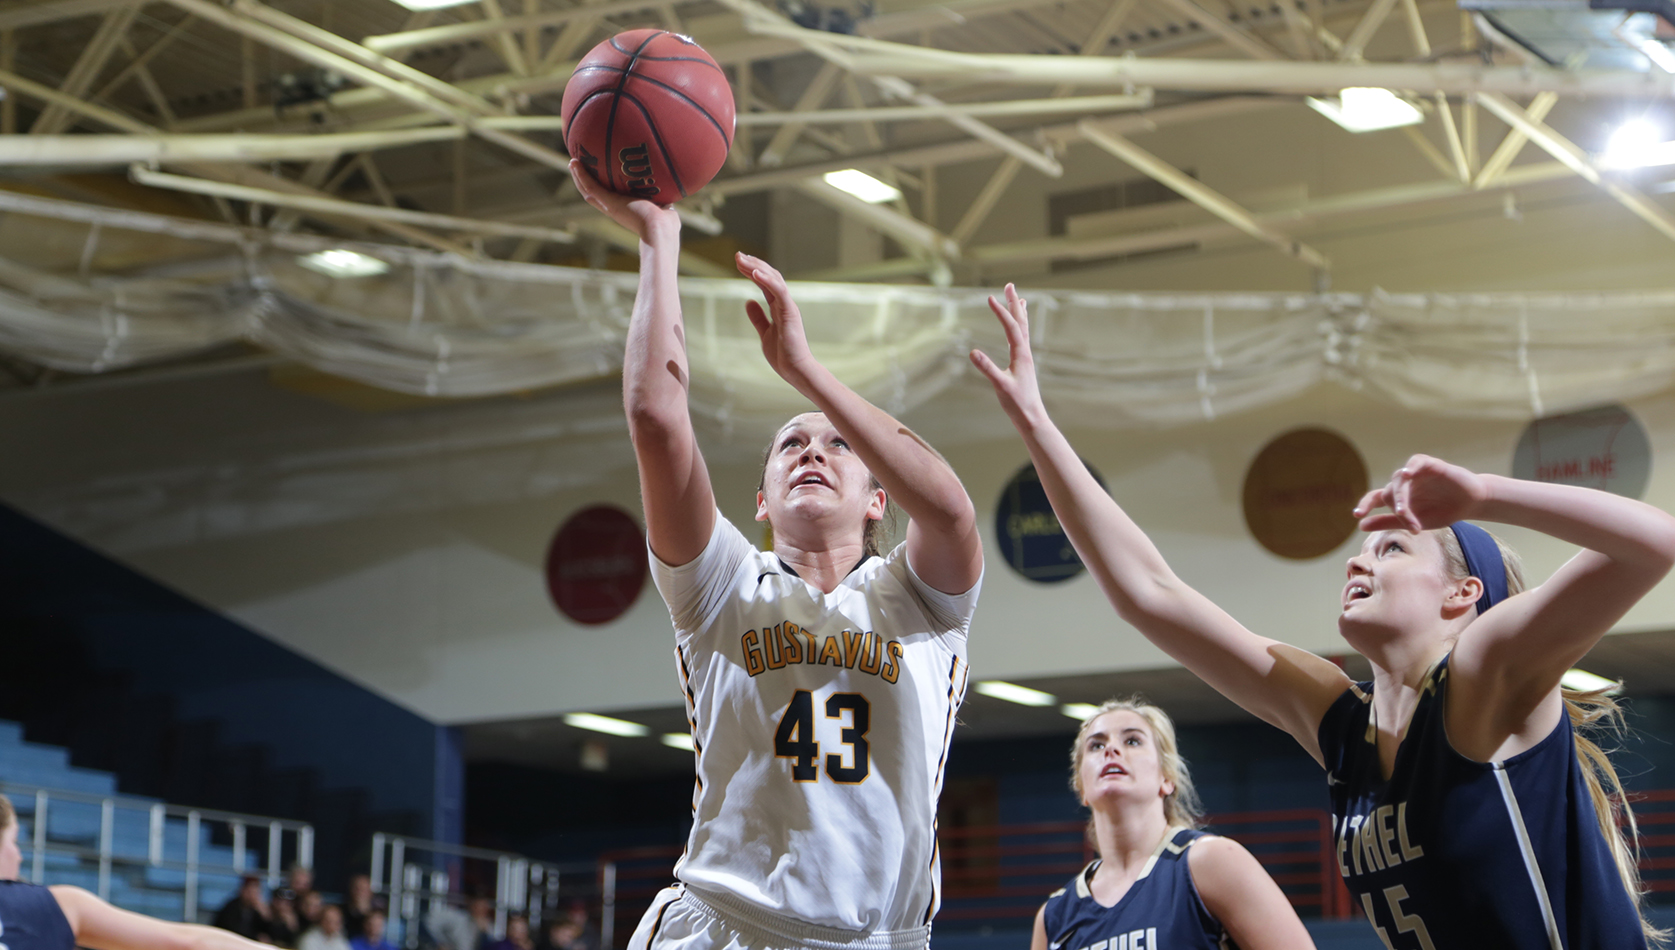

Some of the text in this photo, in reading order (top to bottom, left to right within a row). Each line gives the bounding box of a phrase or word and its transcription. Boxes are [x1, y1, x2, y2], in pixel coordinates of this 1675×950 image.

[1536, 453, 1618, 480] HAMLINE
[741, 620, 904, 685] GUSTAVUS
[773, 688, 871, 785] 43
